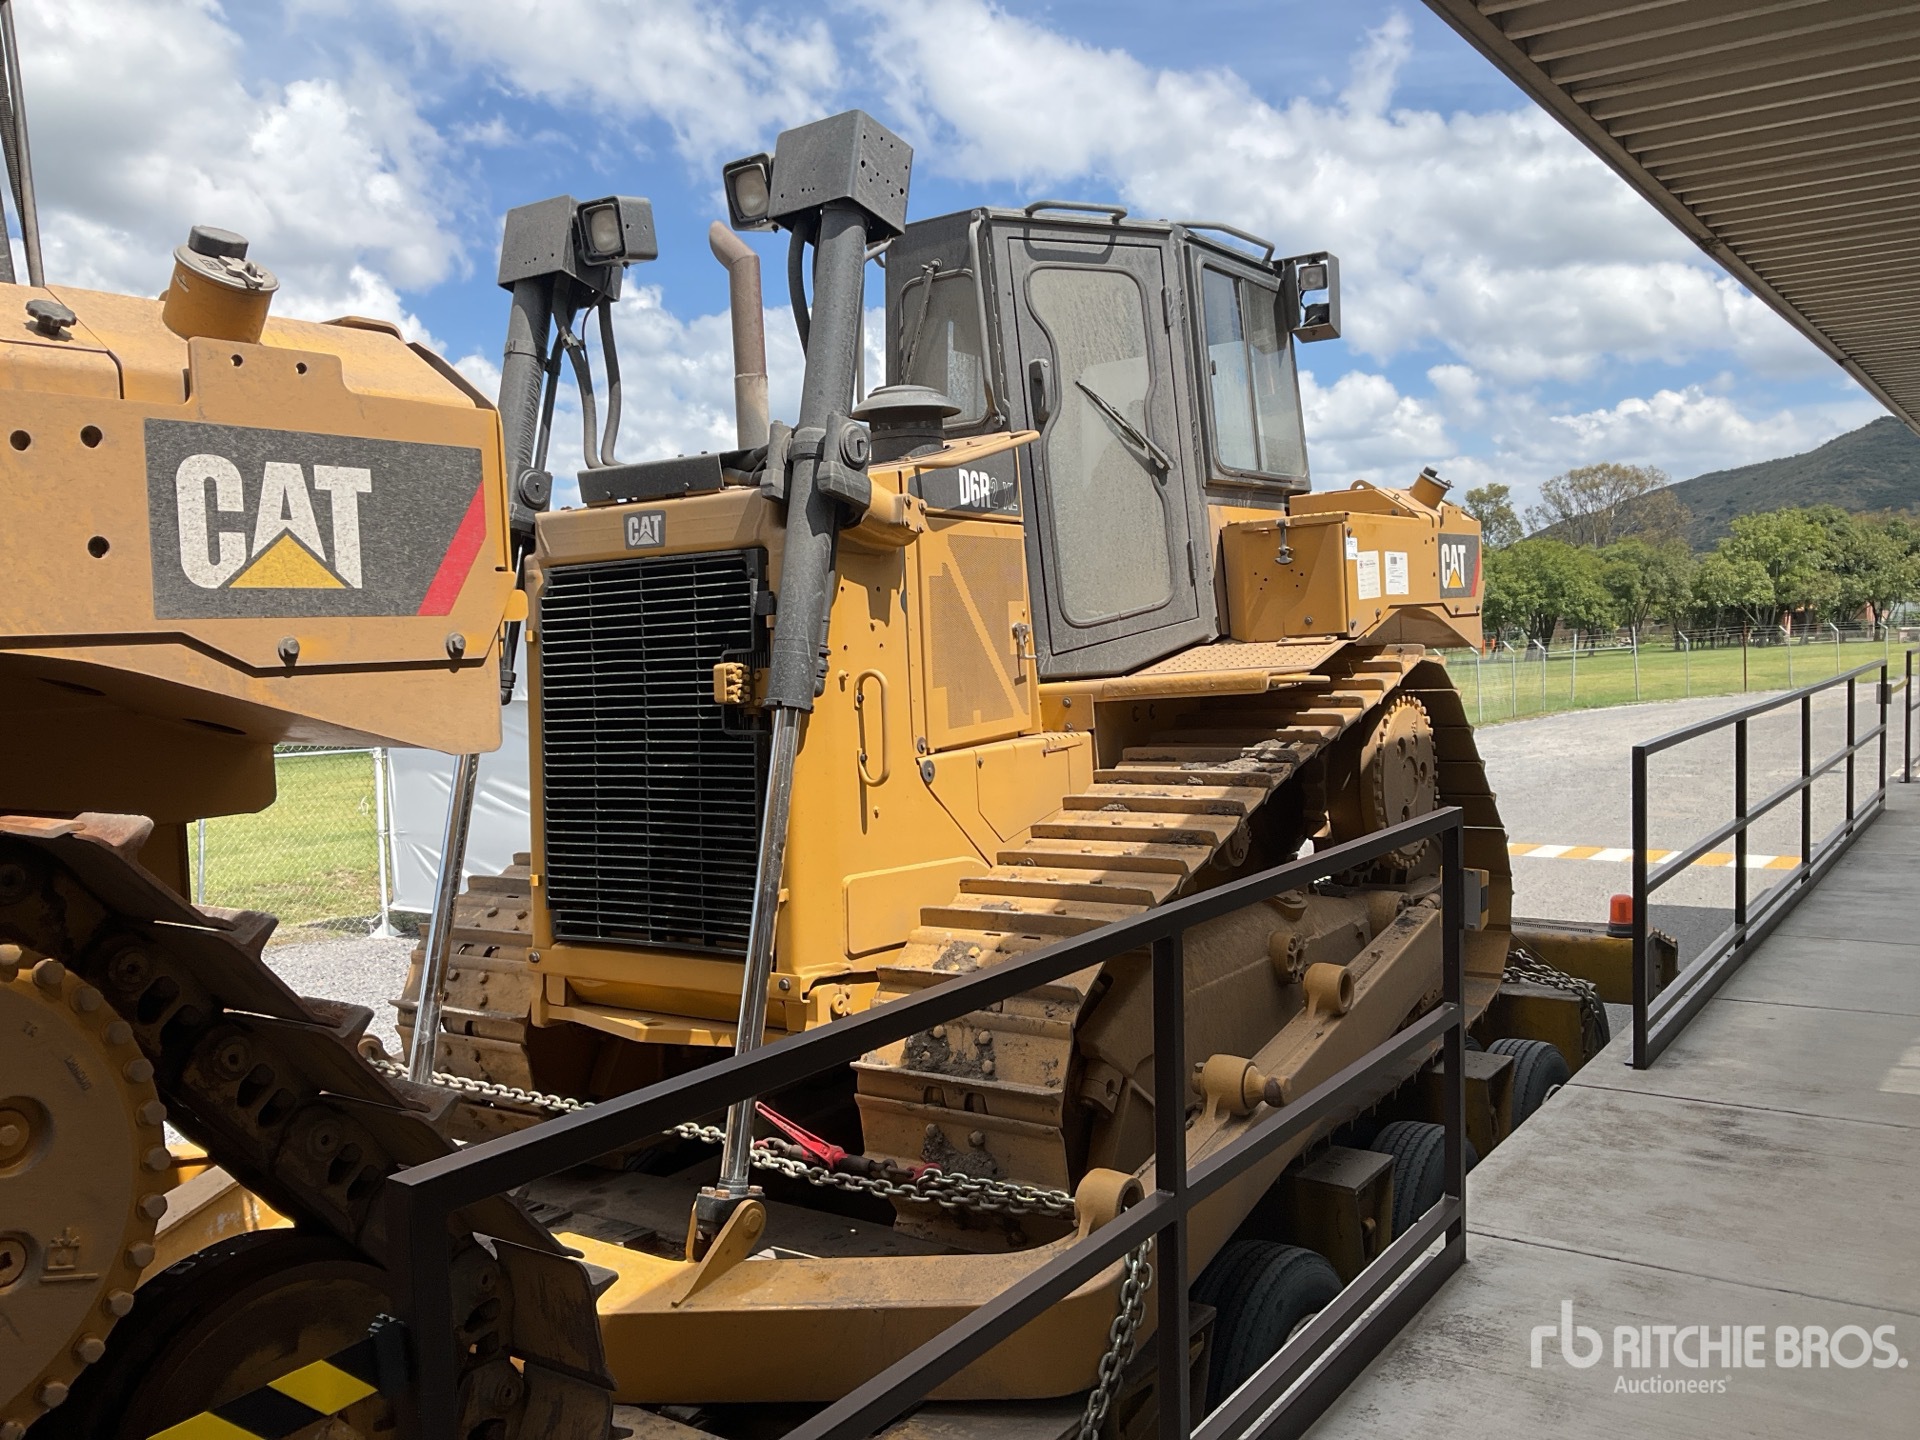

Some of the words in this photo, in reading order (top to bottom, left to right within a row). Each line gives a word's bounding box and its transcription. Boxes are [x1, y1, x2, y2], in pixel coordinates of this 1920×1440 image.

[175, 453, 372, 589] CAT
[628, 515, 662, 546] CAT
[1441, 543, 1466, 589] CAT
